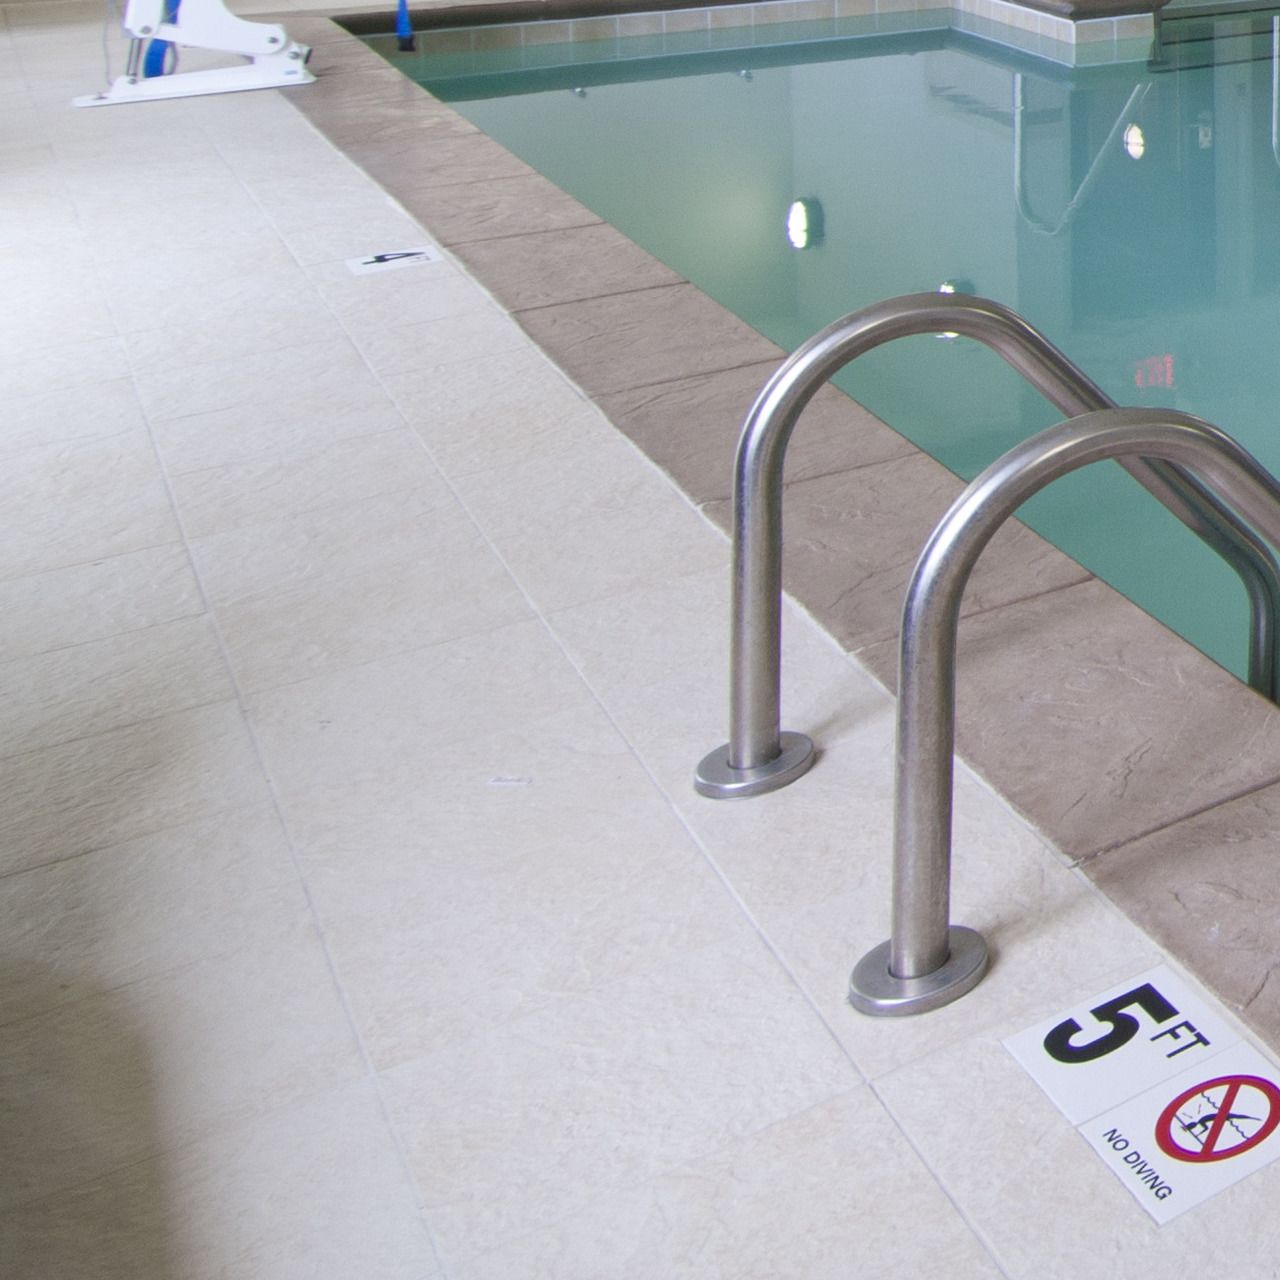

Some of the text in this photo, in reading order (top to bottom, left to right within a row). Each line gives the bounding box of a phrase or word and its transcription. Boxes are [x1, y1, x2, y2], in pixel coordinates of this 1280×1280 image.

[361, 251, 427, 265] 4
[1043, 982, 1211, 1064] 5 FT
[1102, 1128, 1172, 1200] NO DIVING
